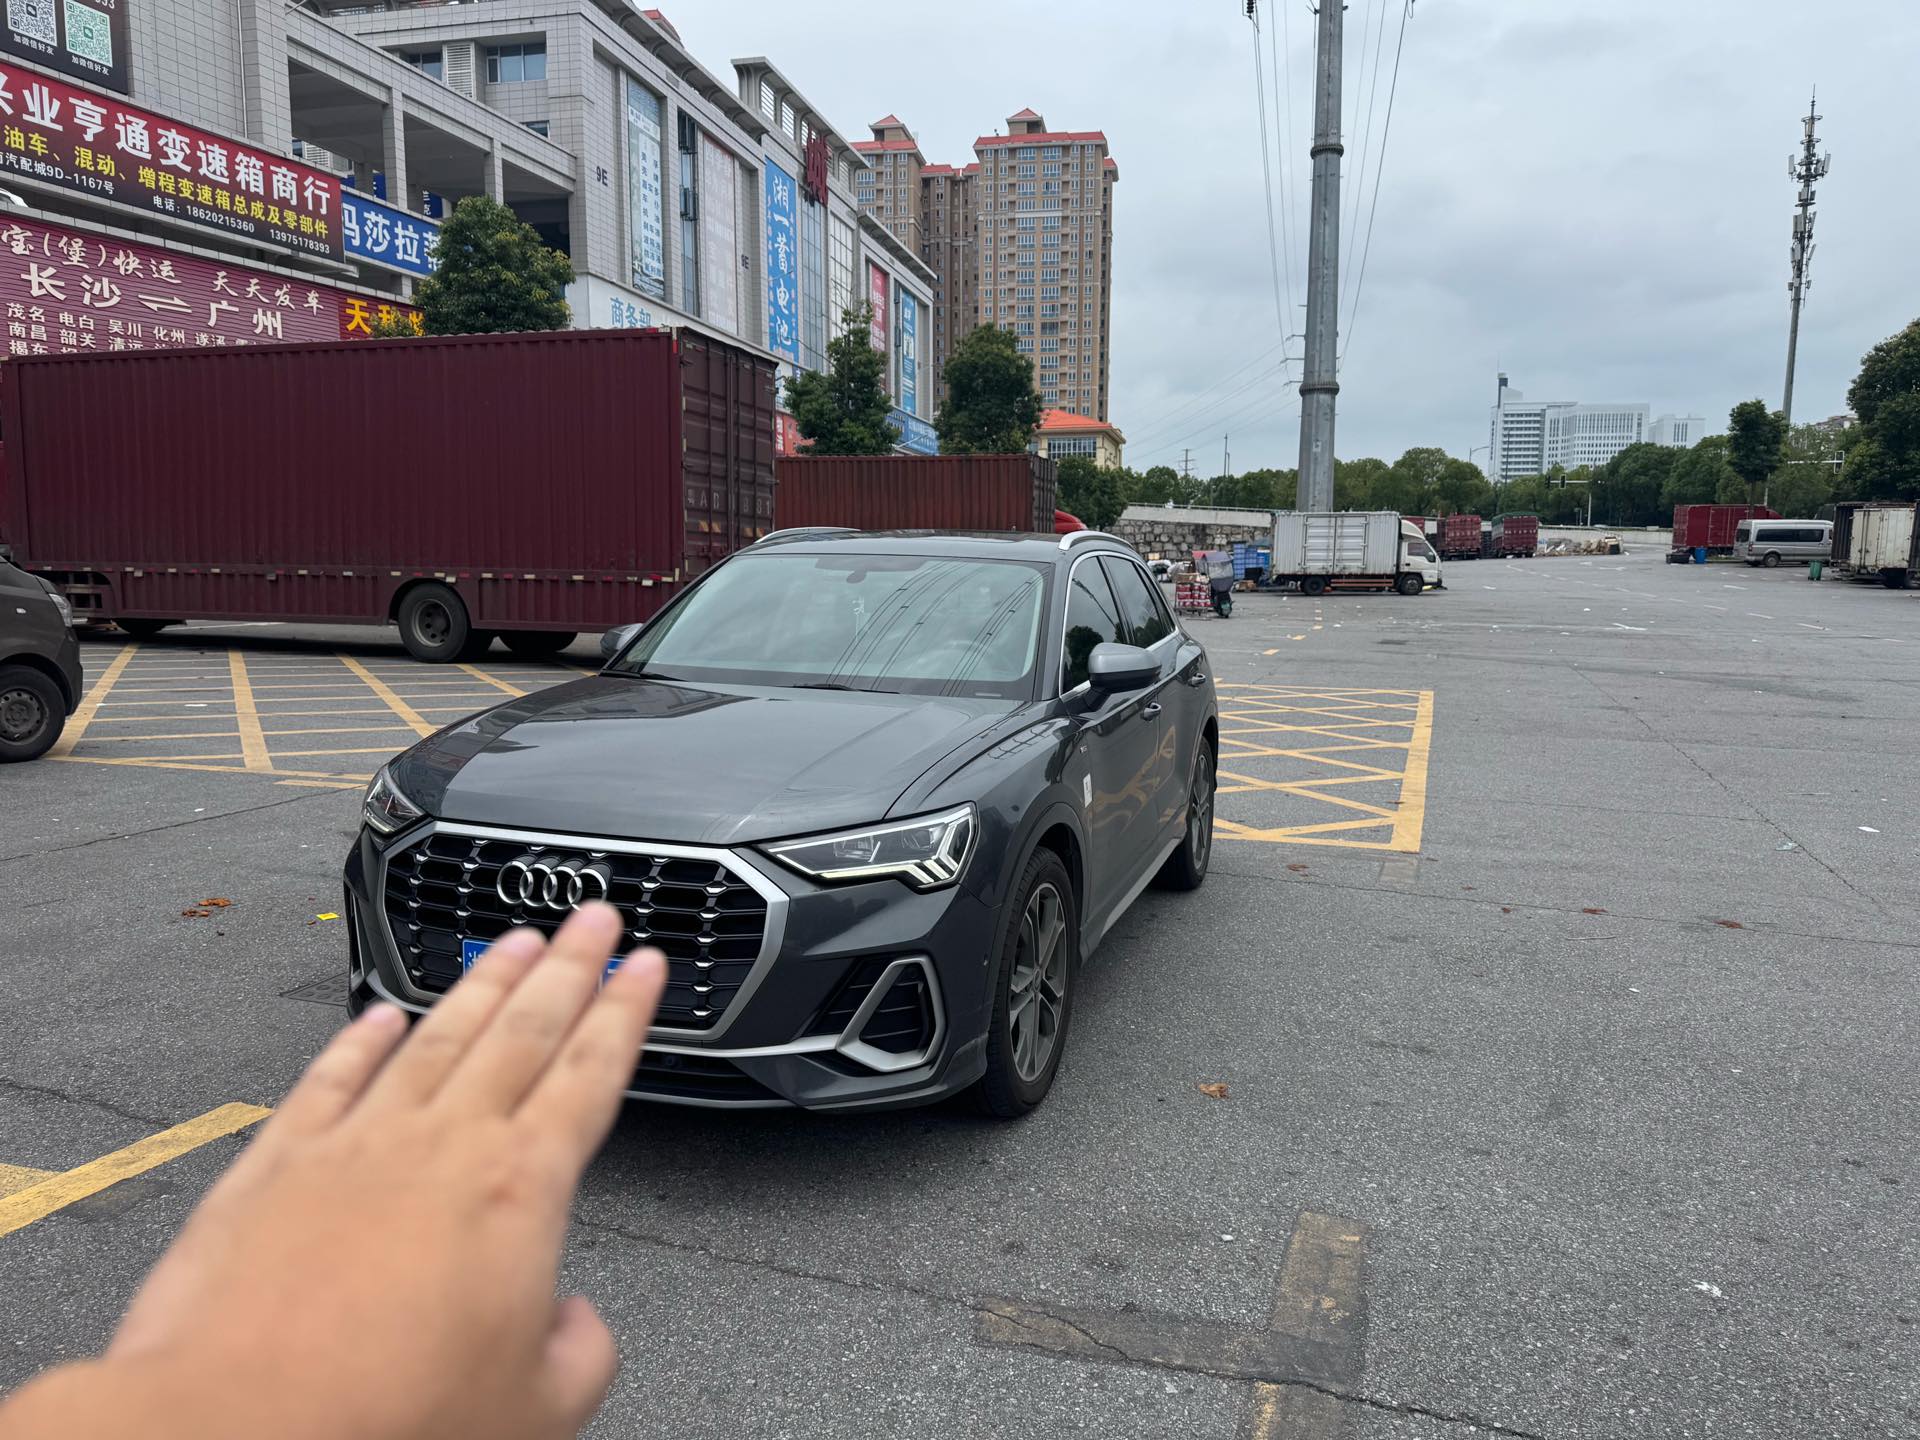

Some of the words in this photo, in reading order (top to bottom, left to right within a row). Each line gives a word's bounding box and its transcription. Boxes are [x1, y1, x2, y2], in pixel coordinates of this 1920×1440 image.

[13, 34, 54, 56] 加微信好友
[72, 55, 109, 76] 加微信好友
[596, 165, 608, 187] 9E
[270, 229, 329, 254] 13975178393
[773, 174, 791, 346] 湘一蓄电池
[21, 262, 122, 308] 长沙
[208, 301, 283, 339] 广州
[213, 271, 324, 316] 天天发车
[7, 302, 46, 323] 茂名
[59, 312, 94, 330] 电白
[109, 320, 142, 338] 吴川
[153, 326, 185, 344] 化州
[610, 297, 652, 328] 商务部
[8, 321, 47, 341] 南昌
[59, 329, 96, 348] 韶关
